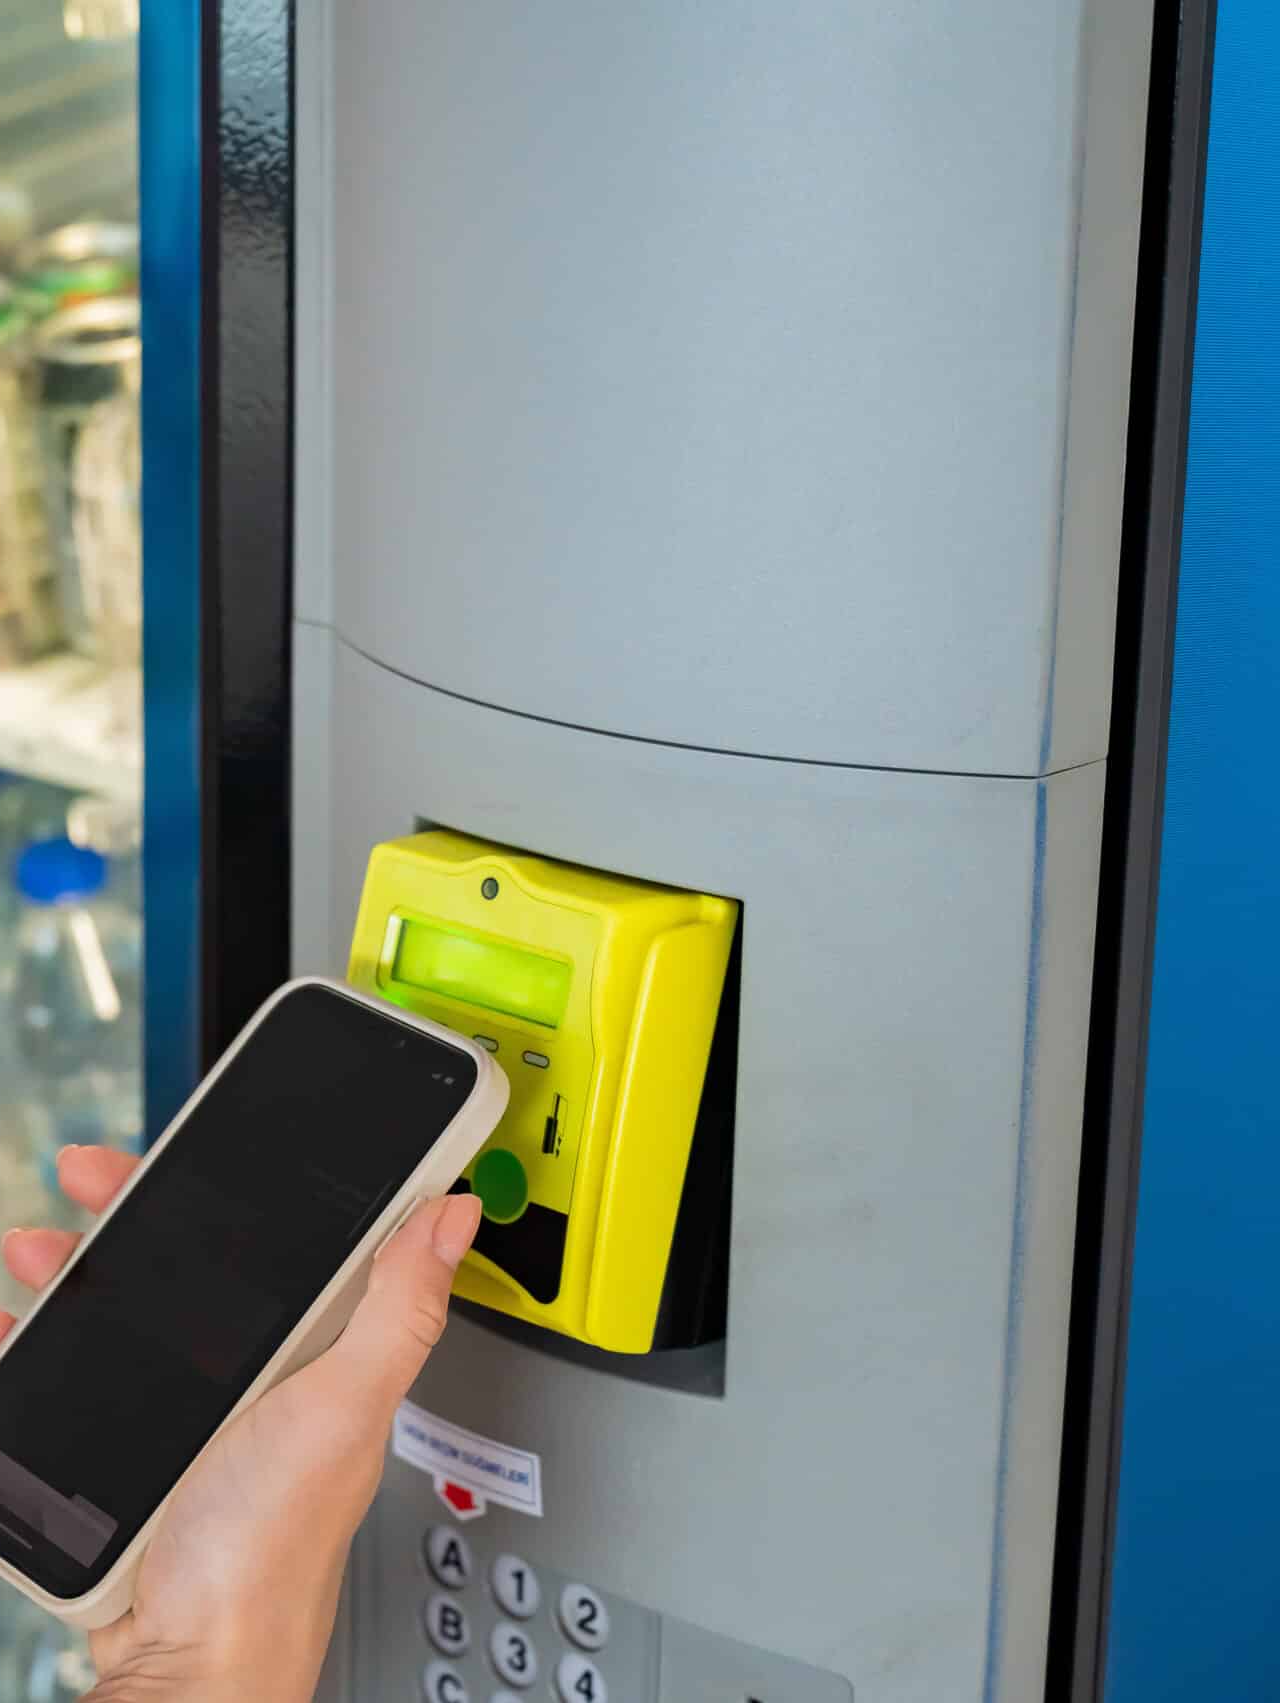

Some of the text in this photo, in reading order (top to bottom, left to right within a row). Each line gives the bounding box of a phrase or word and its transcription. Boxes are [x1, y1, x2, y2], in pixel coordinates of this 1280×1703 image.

[441, 1539, 466, 1576] A
[511, 1570, 524, 1603] 1
[439, 1604, 463, 1641] B
[577, 1598, 598, 1635] 2
[507, 1636, 527, 1672] 3
[437, 1674, 462, 1703] C
[575, 1669, 594, 1702] 4
